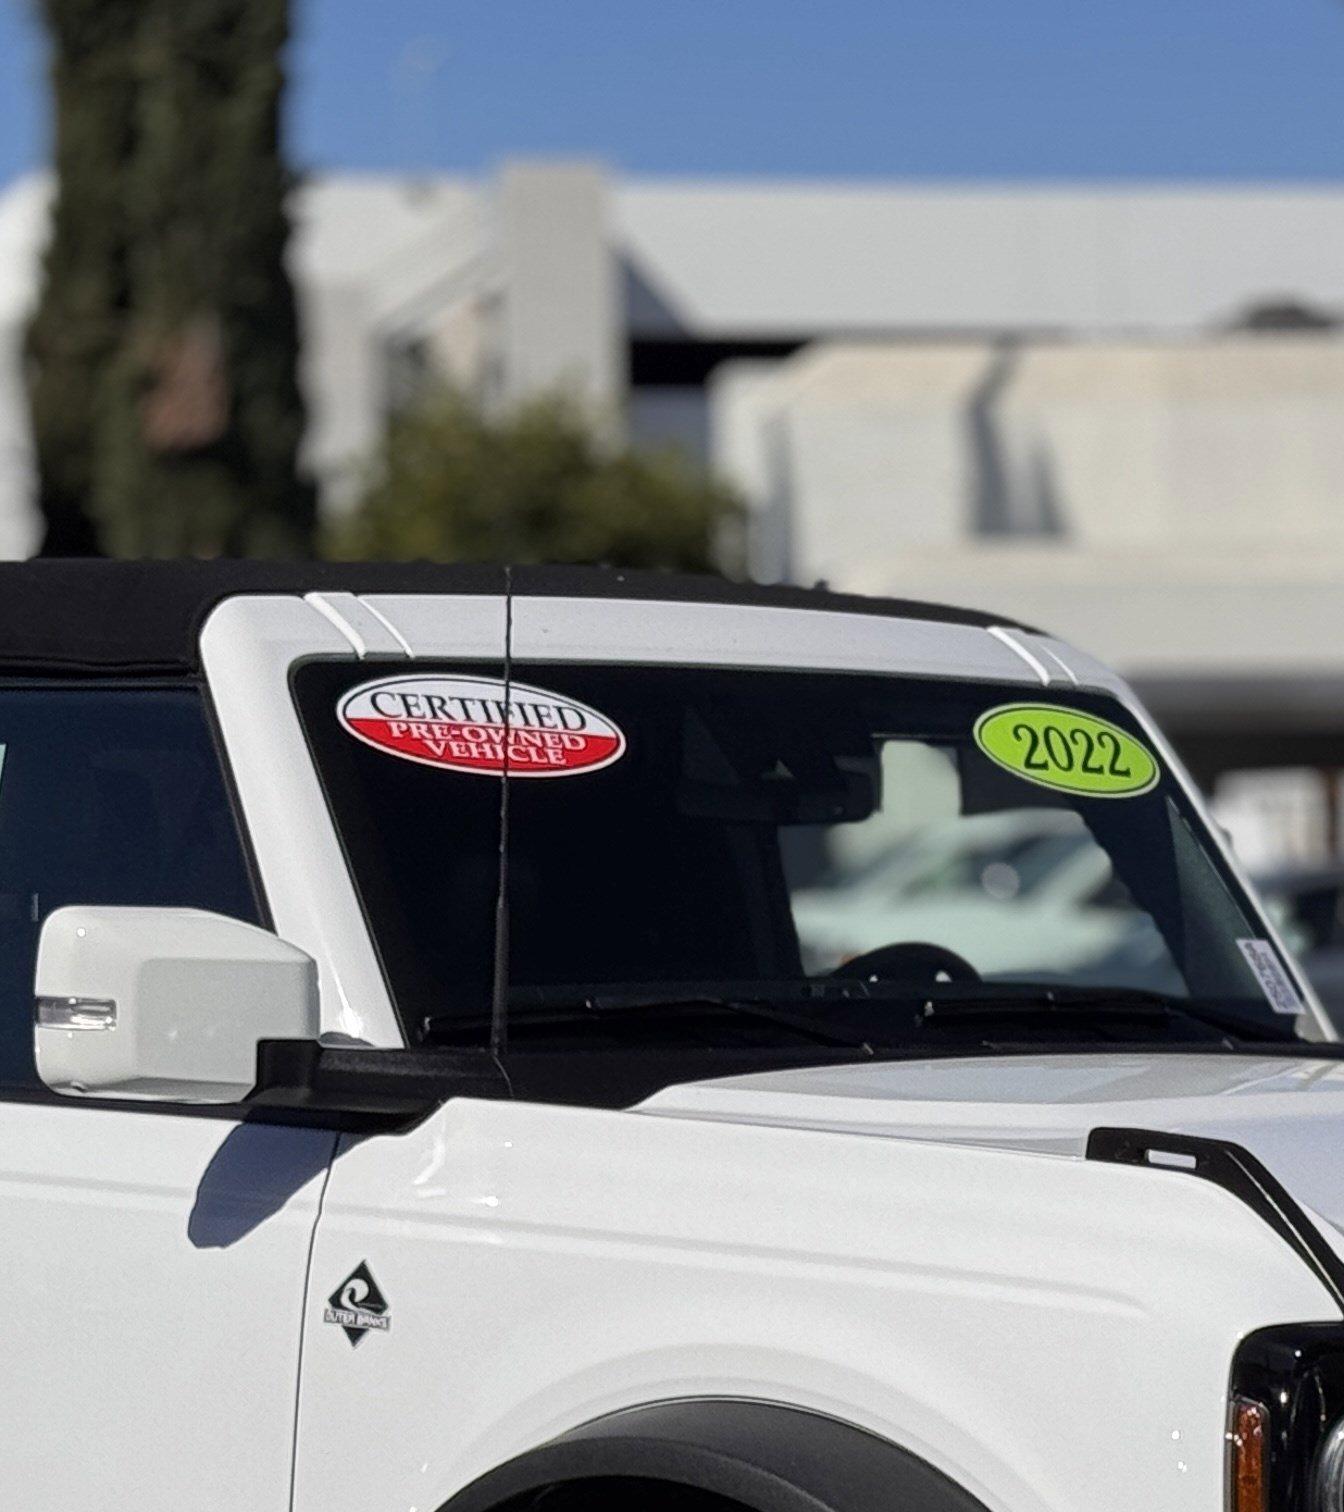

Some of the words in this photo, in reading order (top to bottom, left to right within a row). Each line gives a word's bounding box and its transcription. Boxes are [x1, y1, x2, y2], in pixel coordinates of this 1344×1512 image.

[370, 692, 588, 732] CERTIFIED
[387, 721, 587, 751] PRE-OWNED
[424, 739, 567, 765] VEHICLE
[1012, 723, 1132, 779] 2022
